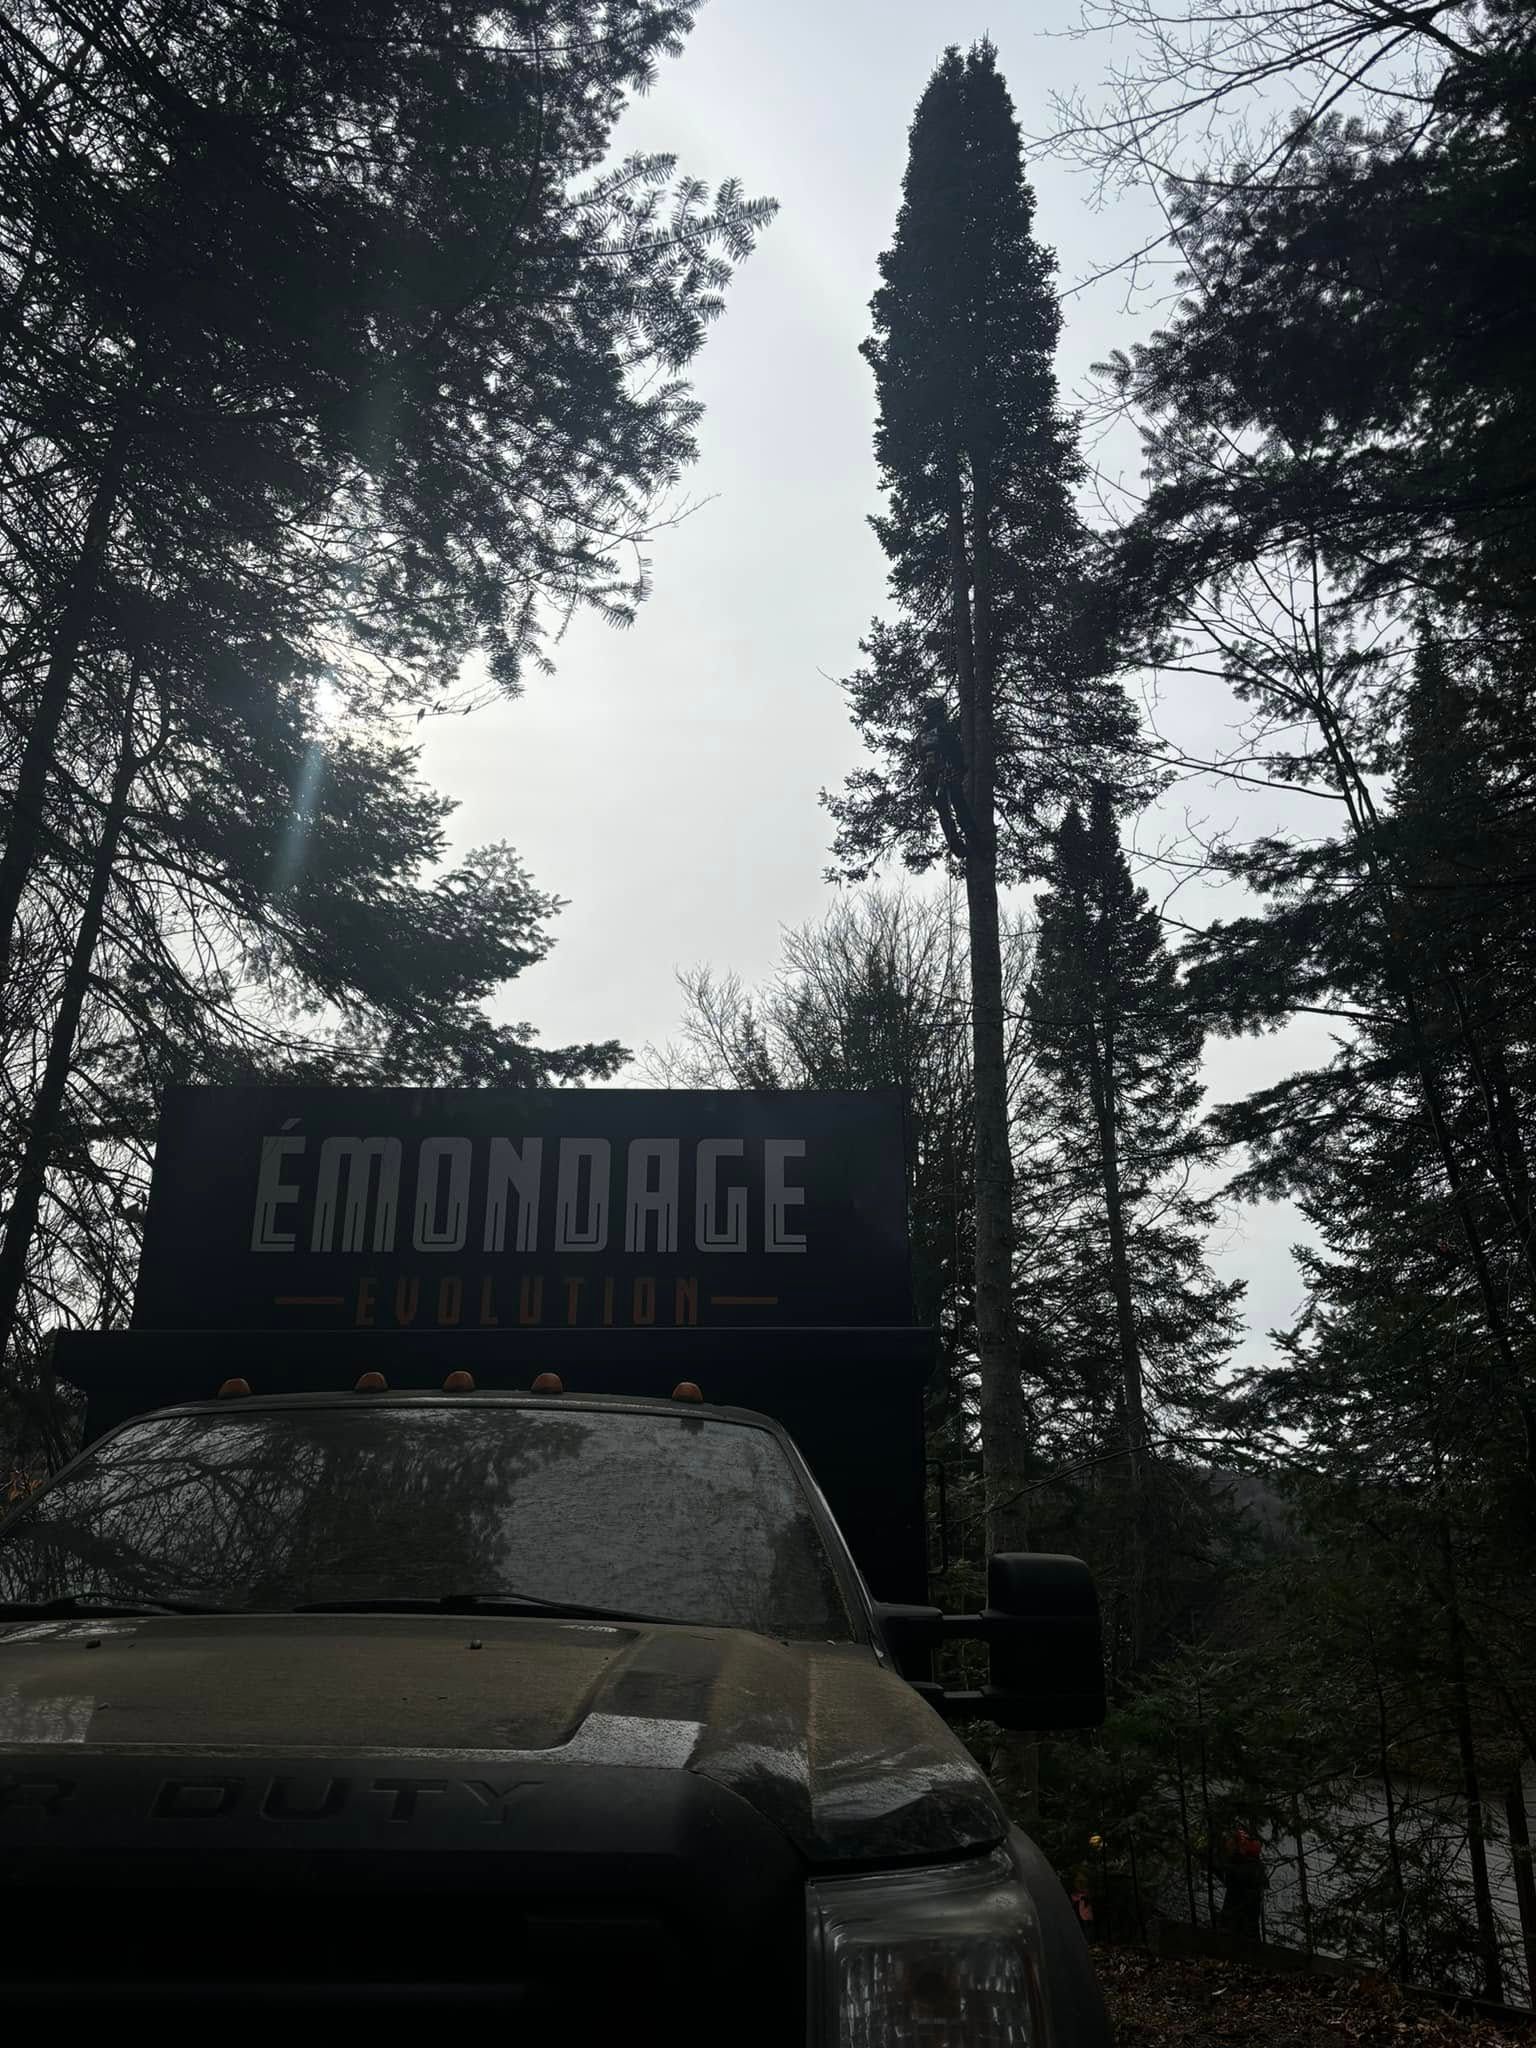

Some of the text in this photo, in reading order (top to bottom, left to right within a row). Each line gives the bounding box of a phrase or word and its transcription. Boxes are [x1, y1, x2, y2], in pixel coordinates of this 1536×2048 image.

[251, 1118, 808, 1253] ÉMONDAGE
[355, 1278, 700, 1326] EVOLUTION
[147, 1776, 544, 1824] DUTY
